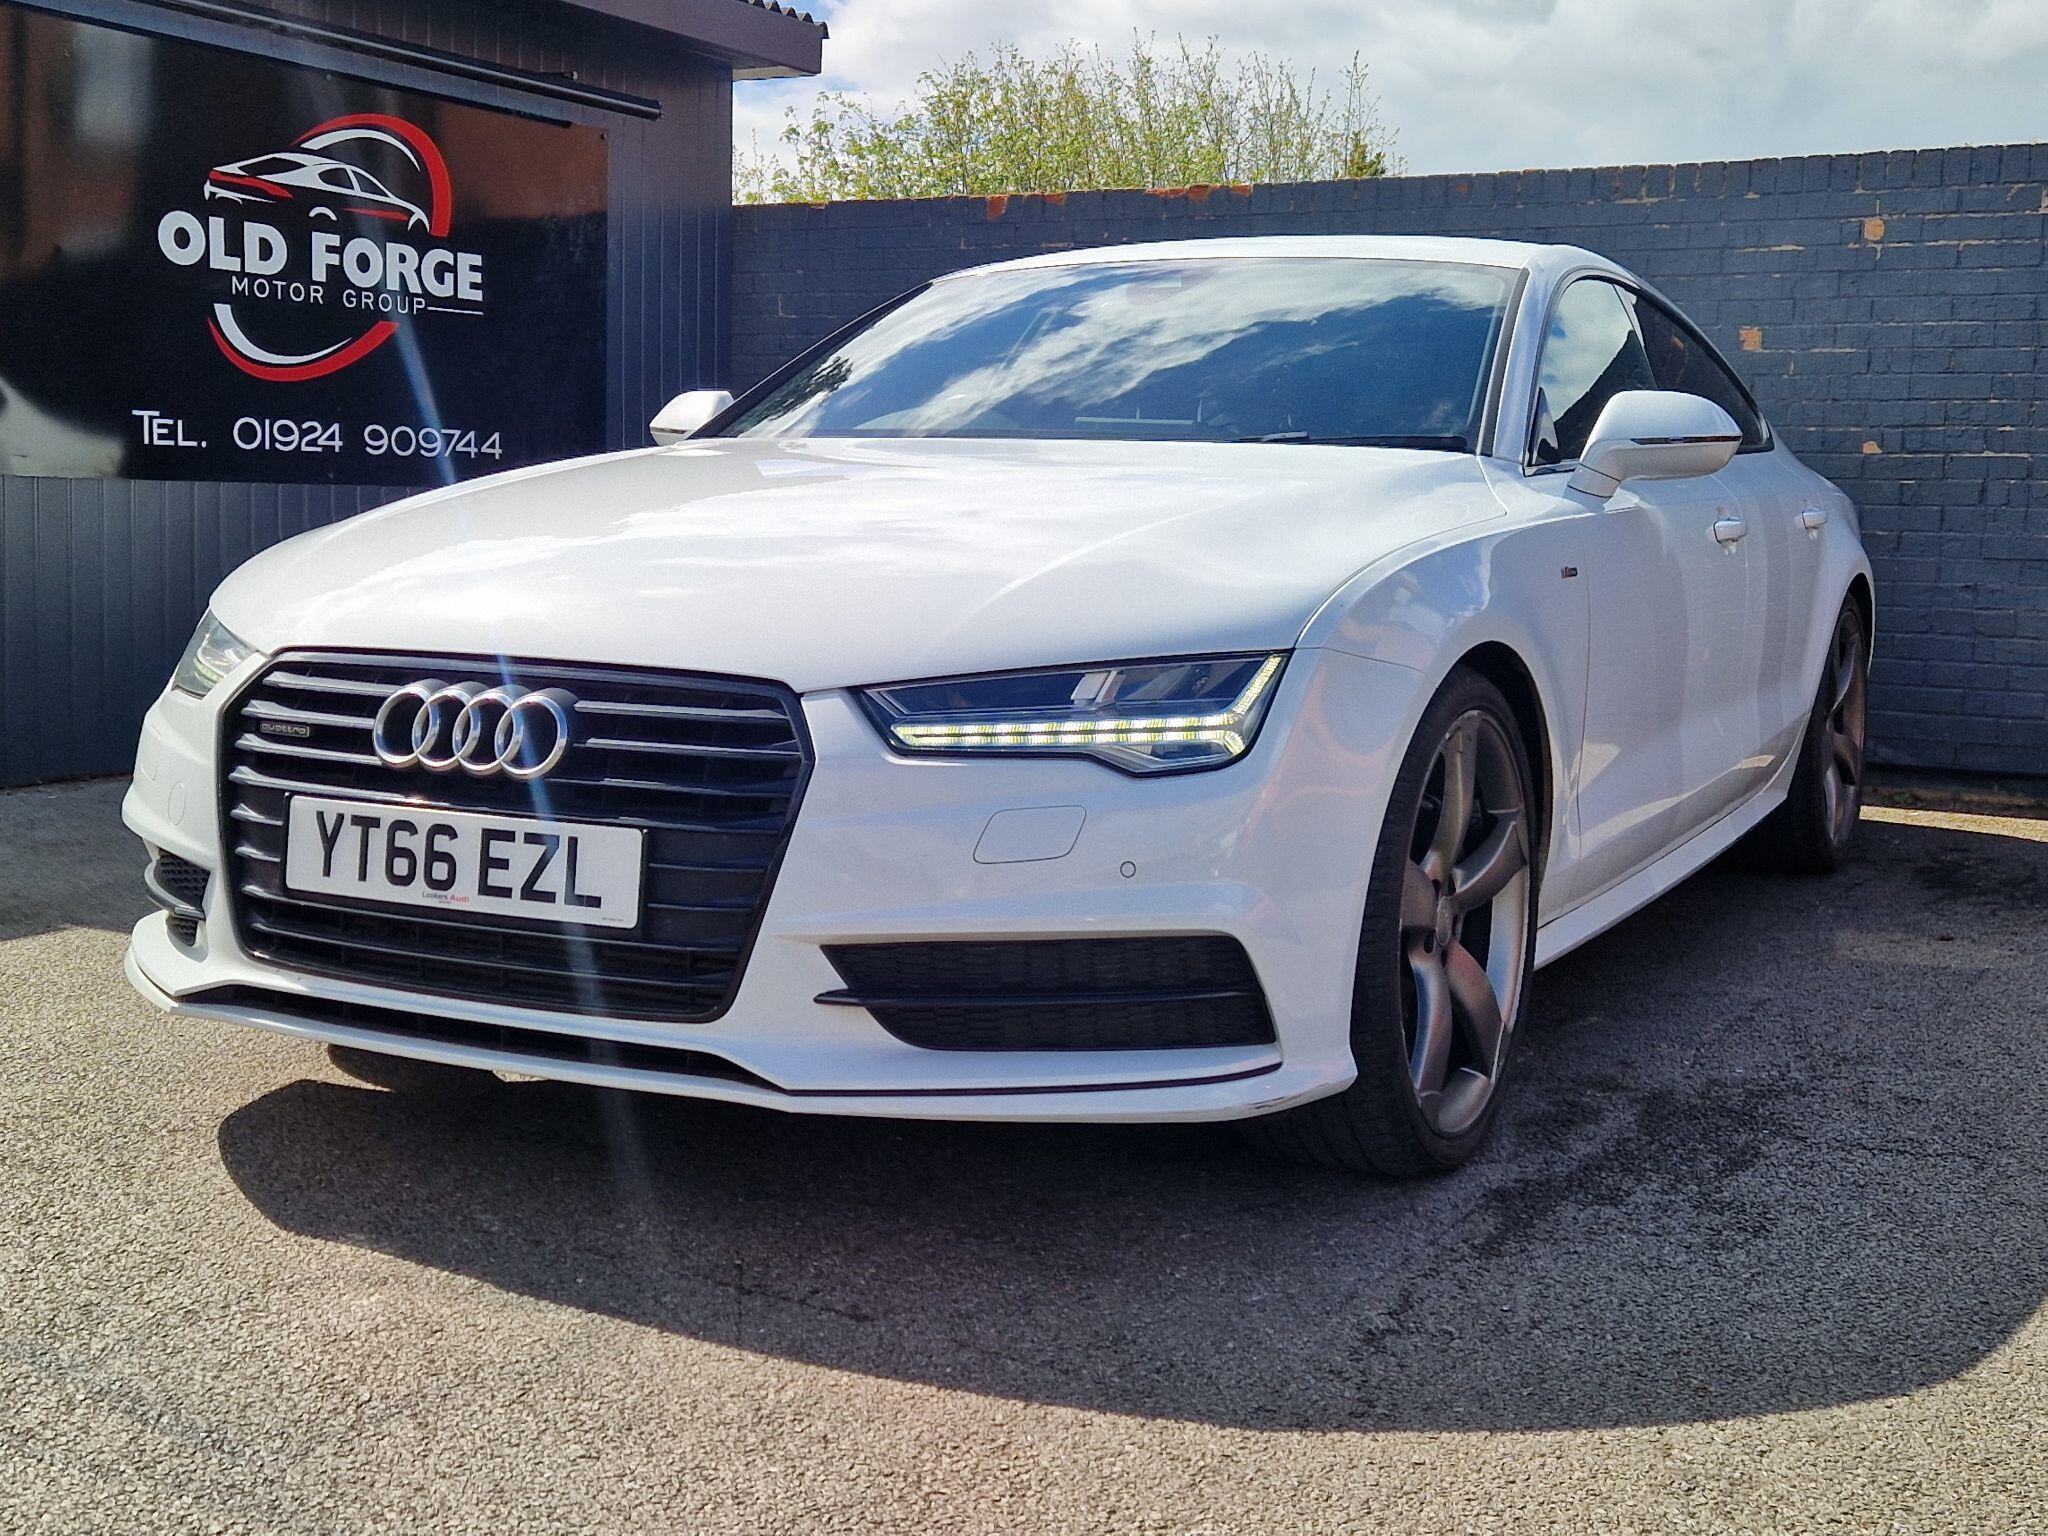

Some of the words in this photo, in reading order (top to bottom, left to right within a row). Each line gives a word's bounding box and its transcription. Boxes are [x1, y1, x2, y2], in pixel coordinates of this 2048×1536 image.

[158, 210, 288, 275] OLD
[311, 231, 484, 301] FORGE
[232, 275, 324, 305] MOTOR
[343, 289, 426, 315] GROUP
[132, 409, 208, 448] TEL.
[233, 416, 344, 453] 01924
[364, 423, 503, 460] 909744
[316, 810, 459, 892] YT66
[477, 827, 603, 909] EZL
